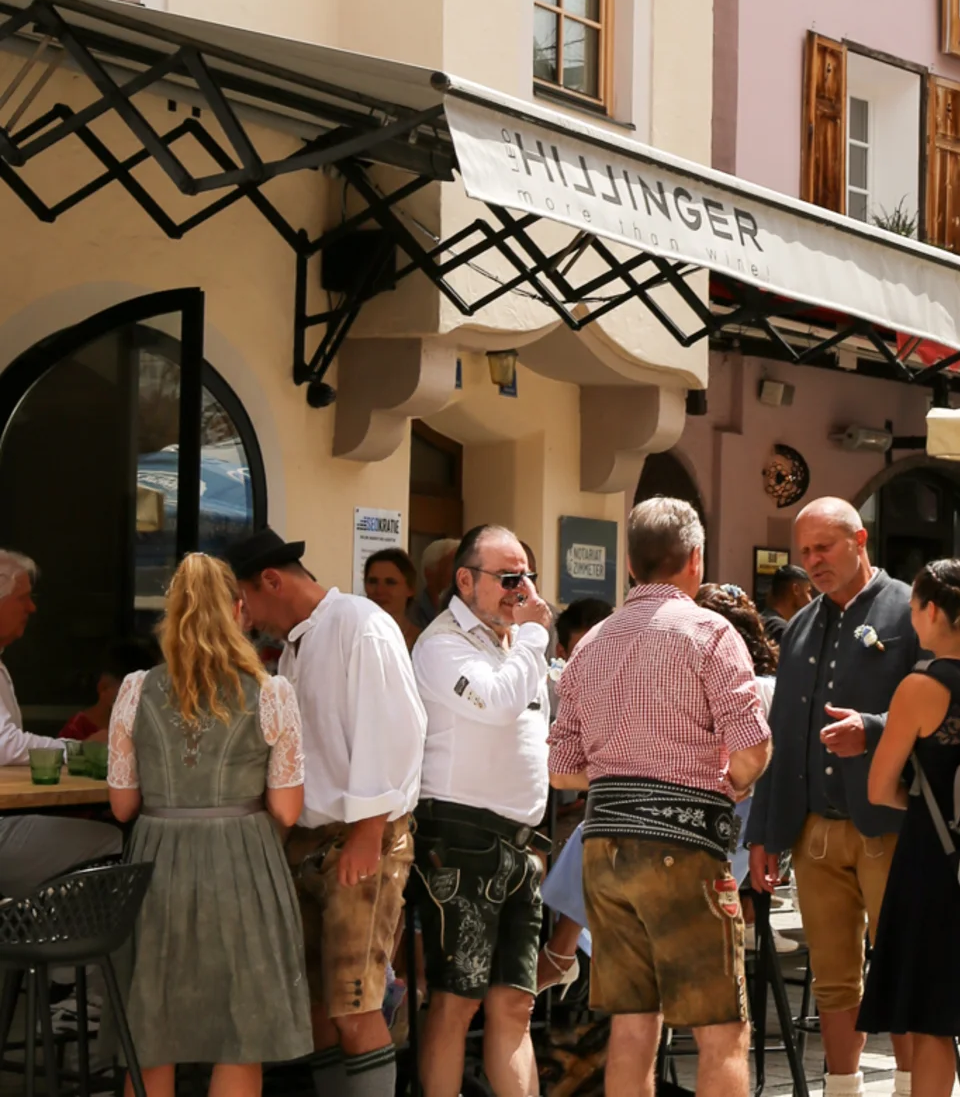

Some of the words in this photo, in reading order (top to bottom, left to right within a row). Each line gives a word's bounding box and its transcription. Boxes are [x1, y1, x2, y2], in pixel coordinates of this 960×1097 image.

[514, 132, 764, 252] HILLINGER
[517, 189, 592, 223] more
[618, 219, 679, 253] than
